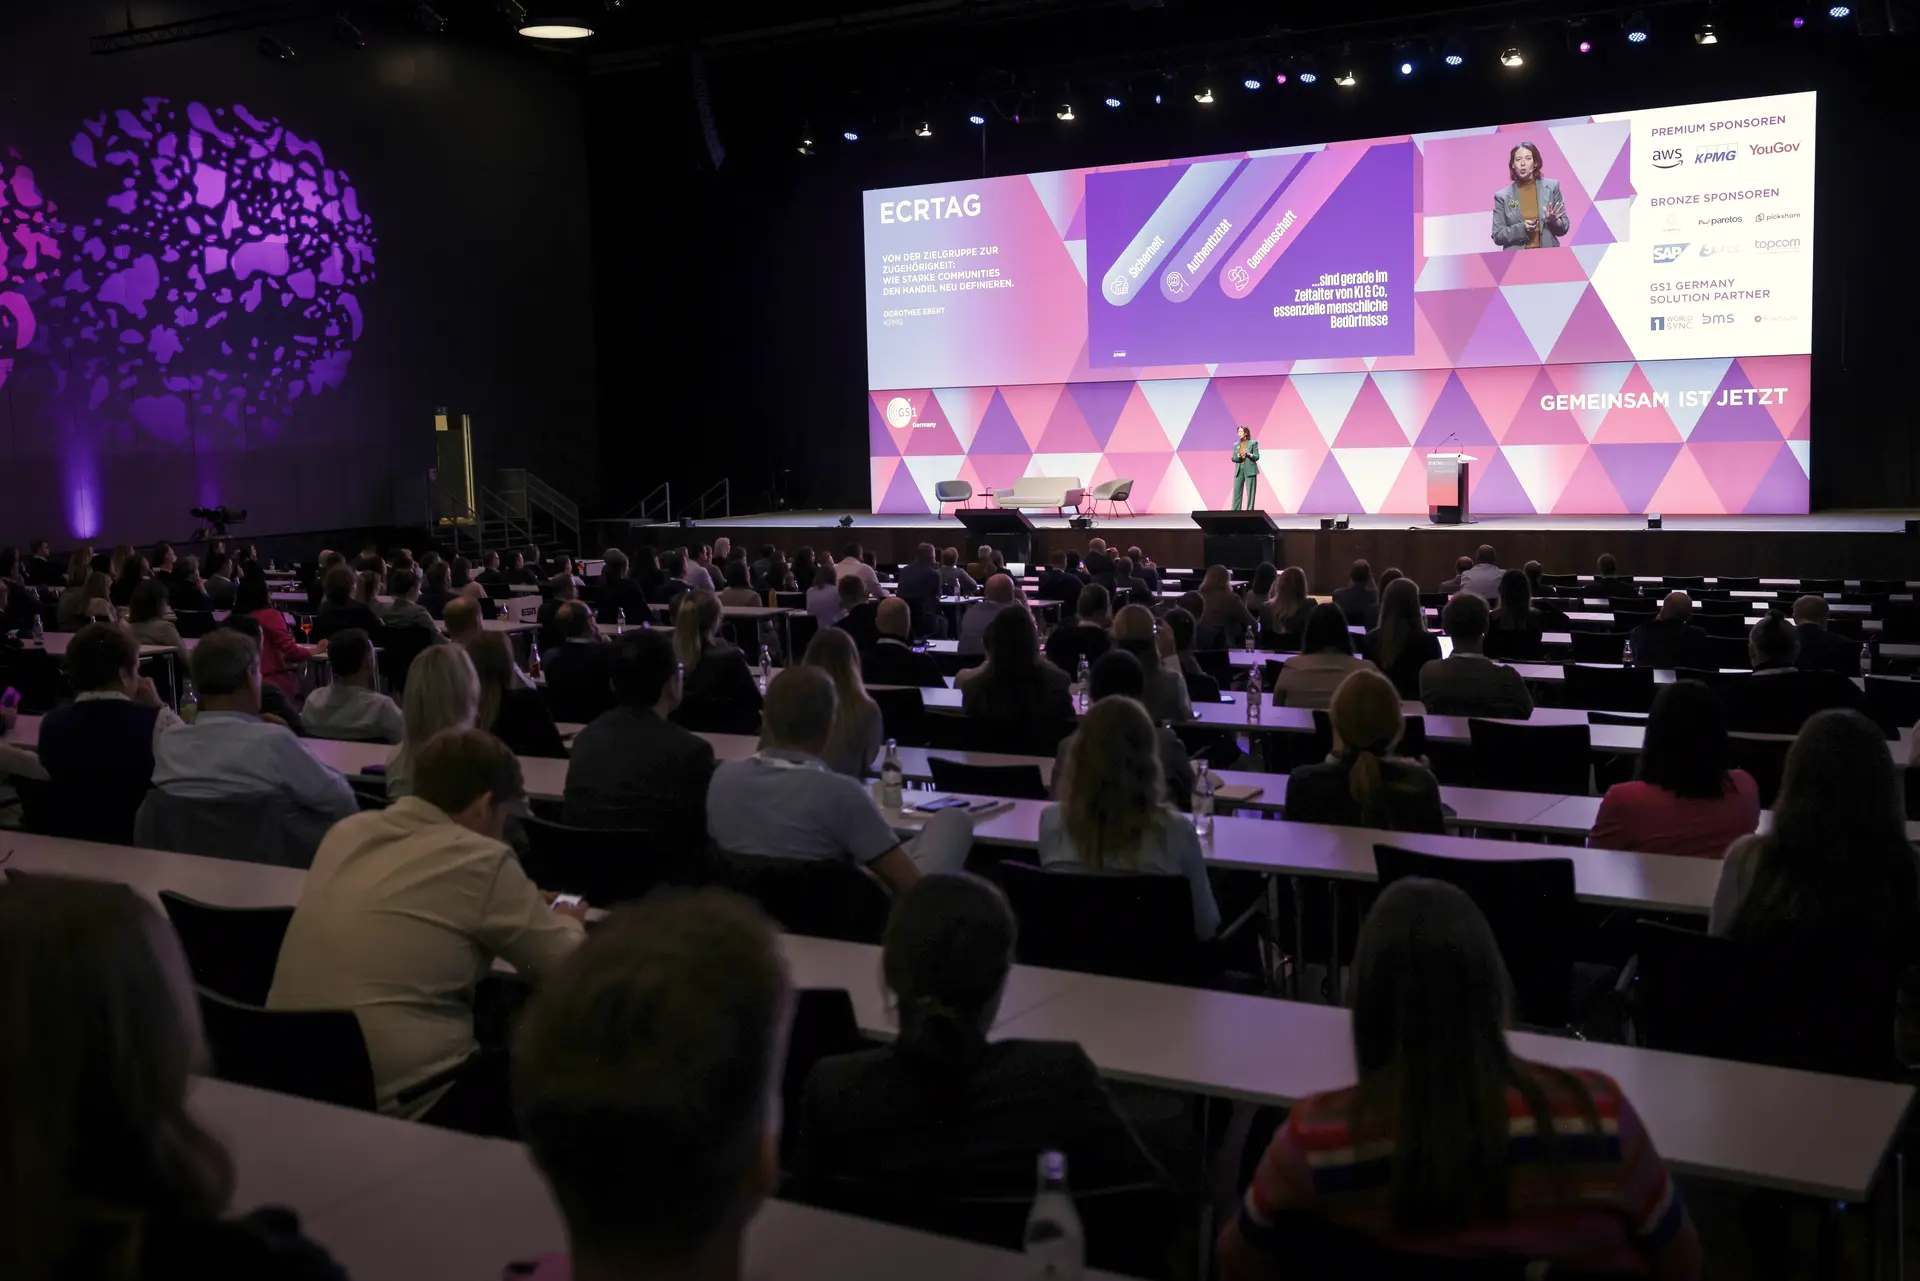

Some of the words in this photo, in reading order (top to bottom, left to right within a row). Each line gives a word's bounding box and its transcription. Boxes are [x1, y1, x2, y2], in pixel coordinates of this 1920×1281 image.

[1652, 124, 1706, 136] PREMIUM
[1710, 115, 1786, 132] SPONSOREN
[1652, 148, 1682, 161] aws
[1750, 142, 1800, 156] YouGov
[1694, 150, 1736, 164] KPMG
[1651, 195, 1700, 206] BRONZE
[1704, 188, 1780, 202] SPONSOREN
[880, 194, 981, 224] ECRTAG
[1711, 216, 1742, 226] paretos
[1766, 212, 1800, 221] pickshare
[1186, 218, 1232, 274] Authentizität
[1246, 210, 1297, 270] Gemeinschaft
[1754, 238, 1800, 250] topcom
[882, 254, 900, 263] VON
[903, 252, 921, 261] DER
[924, 248, 978, 260] ZIELGRUPPE
[980, 246, 998, 255] ZUR
[1128, 235, 1165, 278] Sicherheit
[1654, 247, 1682, 260] SAP
[882, 260, 956, 274] ZUGEHÖRIGKEIT:
[882, 276, 900, 284] WIE
[902, 273, 935, 283] STARKE
[938, 269, 1000, 280] COMMUNITIES
[1341, 270, 1374, 286] gerade
[883, 286, 900, 296] DEN
[902, 284, 938, 294] HANDEL
[940, 282, 958, 292] NEU
[960, 279, 1014, 290] DEFINIEREN.
[1650, 282, 1672, 292] GS1
[1676, 279, 1735, 290] GERMANY
[1294, 288, 1334, 302] Zeitalter
[1336, 288, 1354, 300] von
[1354, 286, 1364, 298] KI
[1364, 286, 1372, 298] &
[1650, 292, 1710, 304] SOLUTION
[1714, 290, 1770, 300] PARTNER
[883, 309, 921, 318] DOROTHEE
[922, 307, 945, 315] EBERT
[1273, 302, 1326, 317] essenzielle
[1326, 299, 1388, 314] menschliche
[1330, 314, 1388, 328] Bedürfnisse
[1666, 322, 1692, 330] SYNC
[1540, 392, 1670, 411] GEMEINSAM
[1679, 390, 1712, 408] IST
[1716, 388, 1788, 407] JETZT
[898, 408, 918, 418] GS1
